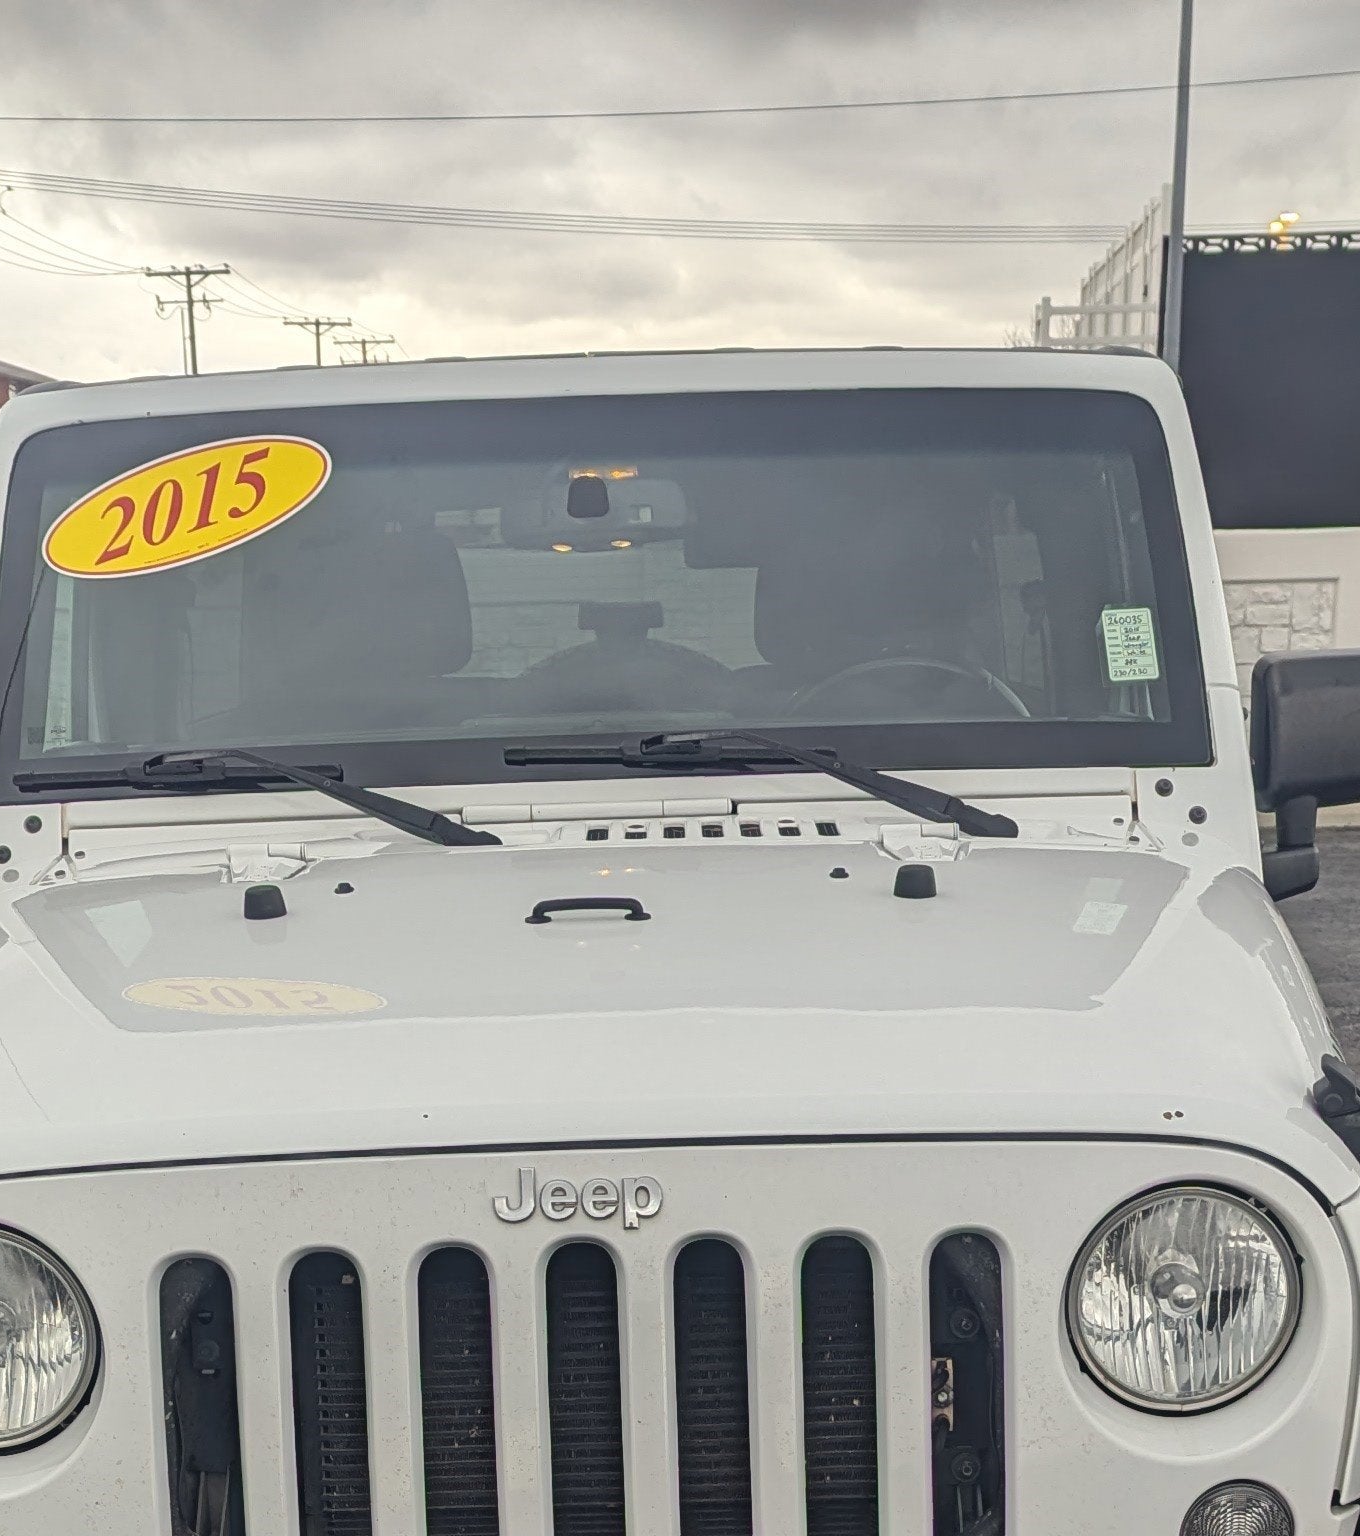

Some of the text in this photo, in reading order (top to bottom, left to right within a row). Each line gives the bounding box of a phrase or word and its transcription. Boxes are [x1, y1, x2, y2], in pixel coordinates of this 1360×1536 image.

[94, 446, 271, 567] 2015
[1107, 614, 1144, 626] 260035
[492, 1167, 663, 1230] Jeep
